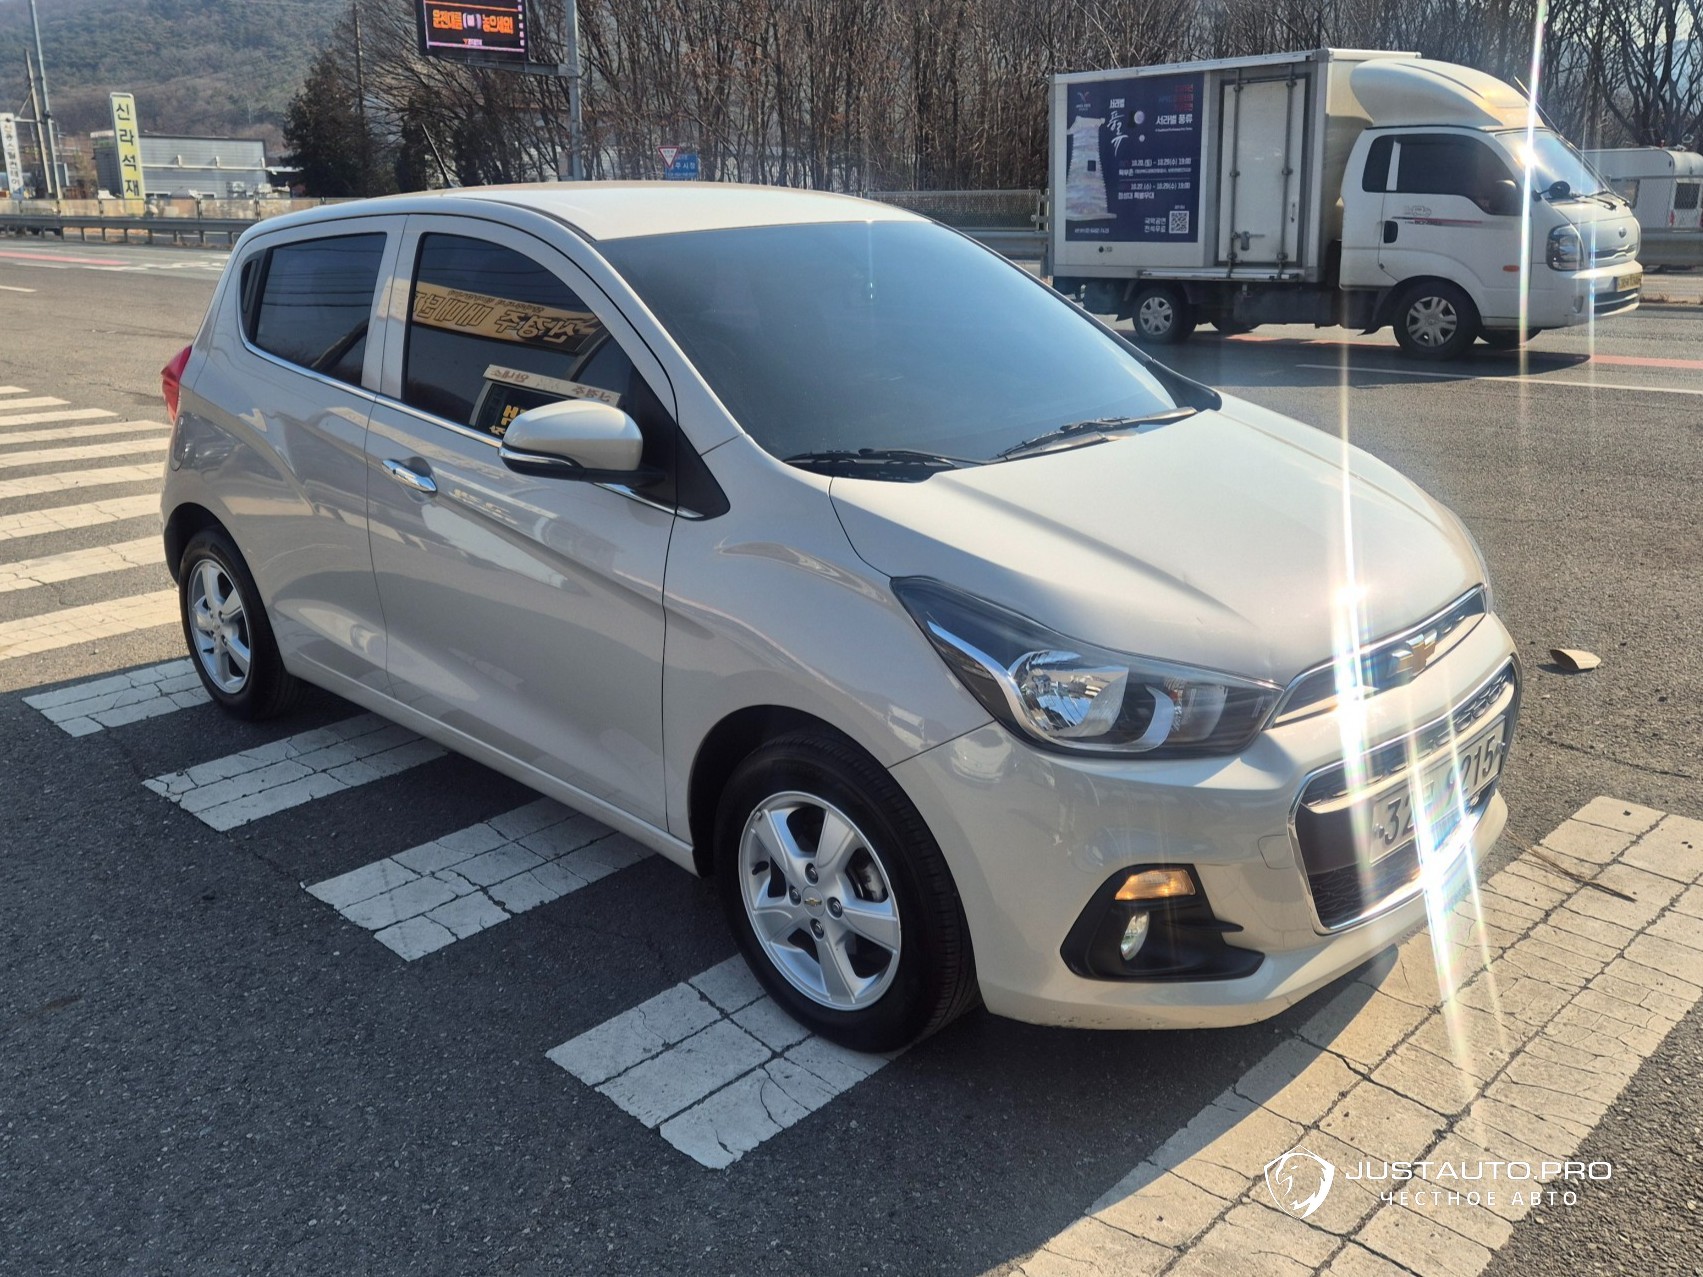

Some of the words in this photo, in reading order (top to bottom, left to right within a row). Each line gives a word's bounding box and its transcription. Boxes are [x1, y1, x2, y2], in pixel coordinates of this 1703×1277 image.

[1155, 114, 1177, 125] 서라벌
[1178, 113, 1193, 125] 풍류
[116, 103, 140, 197] 신라석재
